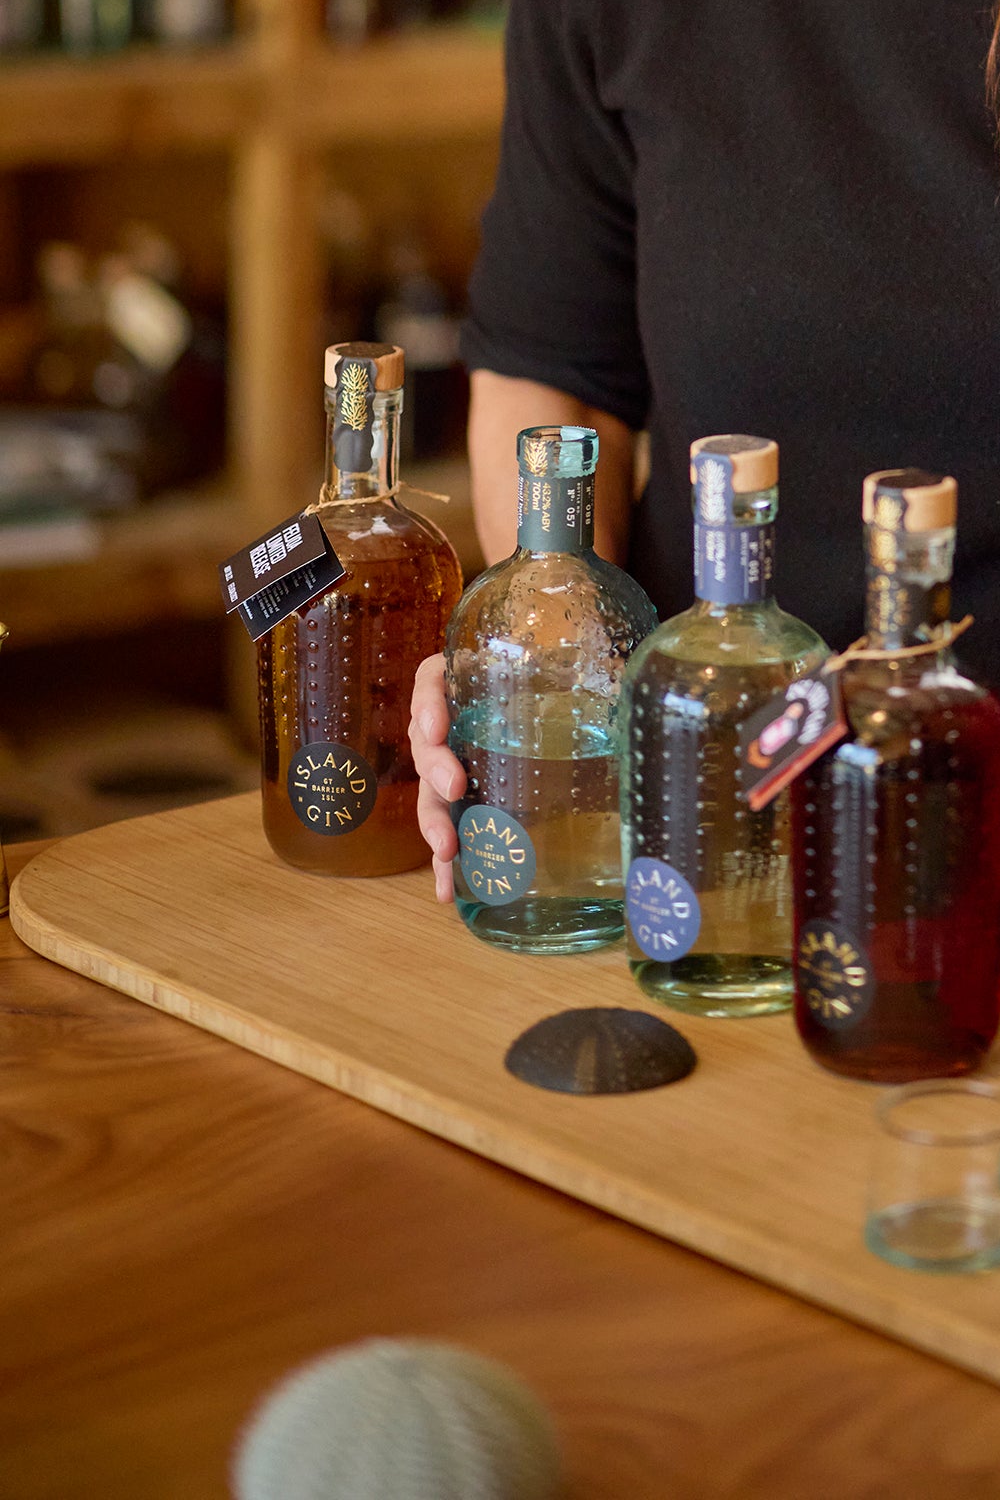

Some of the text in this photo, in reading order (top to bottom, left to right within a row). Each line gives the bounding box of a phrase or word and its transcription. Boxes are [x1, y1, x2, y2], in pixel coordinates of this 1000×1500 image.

[532, 482, 541, 511] 700ml
[541, 511, 551, 533] ABV
[566, 507, 576, 528] 057
[249, 542, 272, 579] RELEASE
[265, 532, 288, 565] LIMITED
[294, 752, 366, 794] ISLAND
[311, 784, 345, 794] BARRIER
[321, 794, 336, 802] ISL
[306, 805, 353, 827] GIN
[463, 817, 526, 865] ISLAND
[471, 870, 513, 895] GIN
[629, 869, 691, 918] ISLAND
[639, 924, 679, 950] GIN
